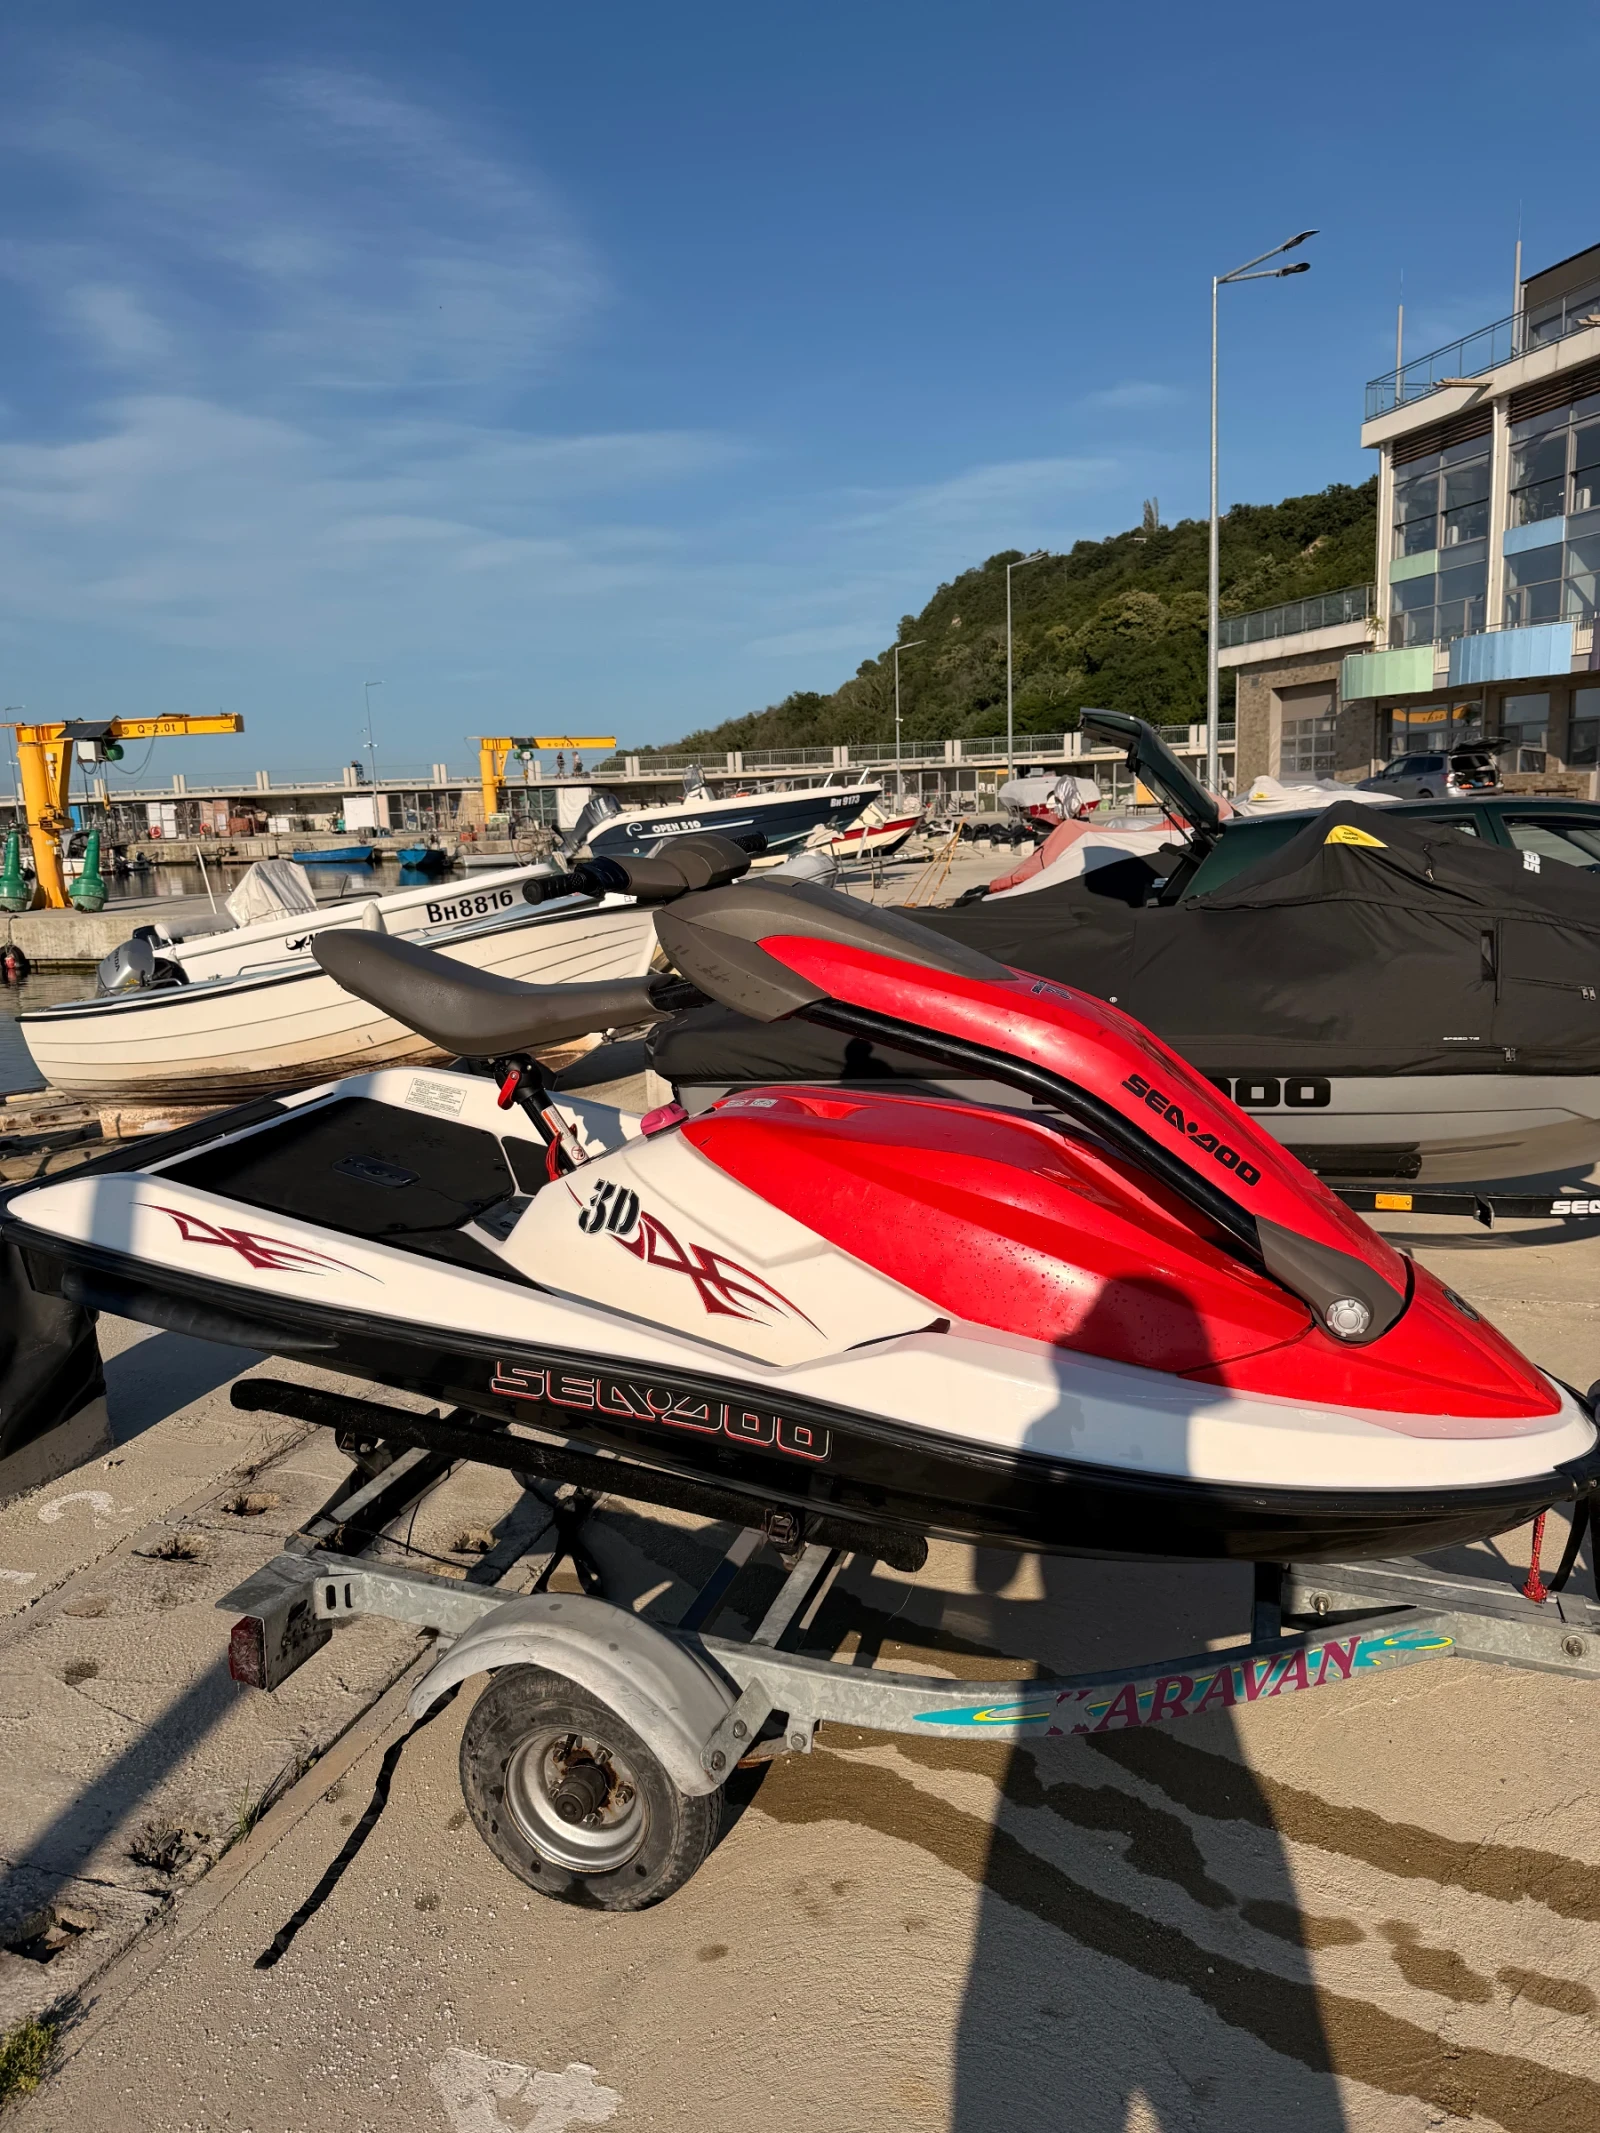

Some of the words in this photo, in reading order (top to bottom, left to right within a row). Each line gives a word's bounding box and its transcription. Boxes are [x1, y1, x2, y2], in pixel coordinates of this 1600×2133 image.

[842, 795, 860, 806] 9173
[652, 822, 680, 833] OPEN
[680, 820, 701, 830] 510
[578, 1178, 640, 1235] 3D
